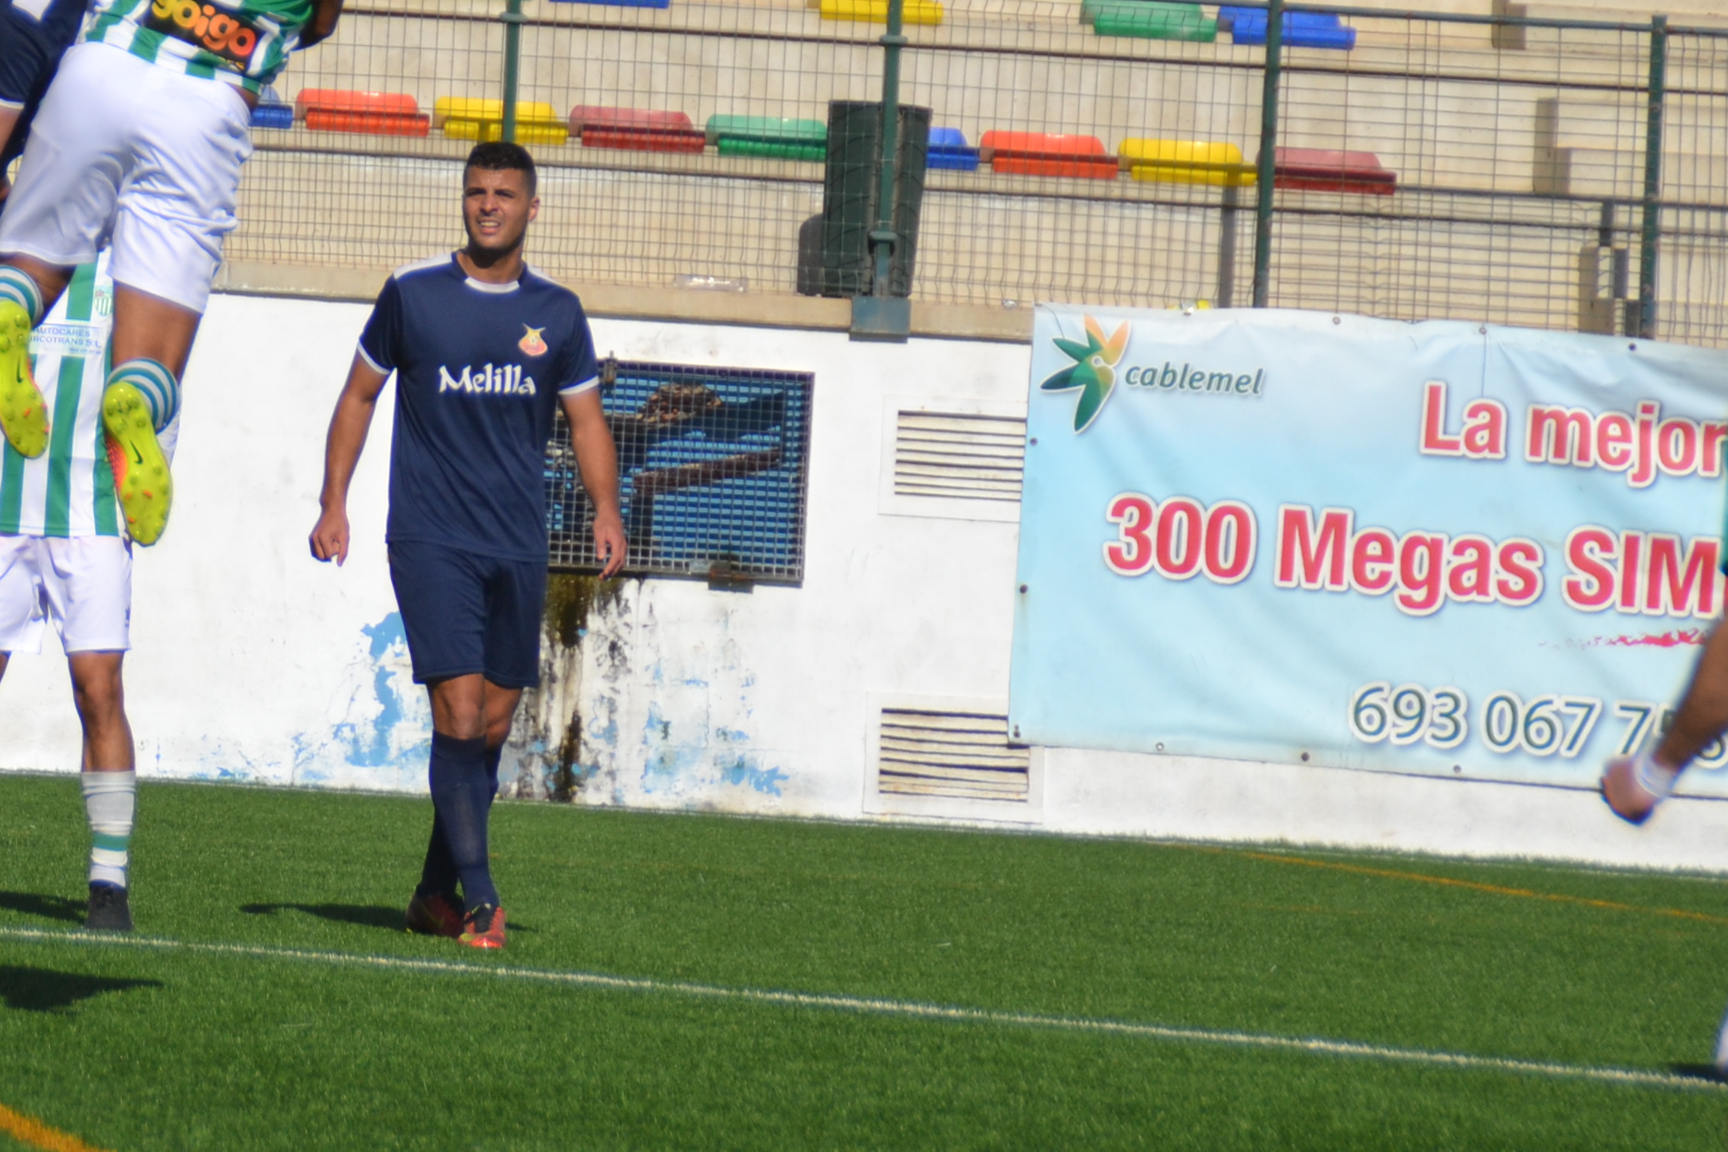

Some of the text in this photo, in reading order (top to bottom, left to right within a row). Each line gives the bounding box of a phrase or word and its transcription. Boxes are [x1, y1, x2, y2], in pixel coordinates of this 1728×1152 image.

[439, 363, 536, 395] Melilla
[1125, 361, 1264, 394] cablemel
[1422, 382, 1728, 484] La mejor
[1106, 494, 1720, 614] 300 Megas SIM
[1352, 684, 1463, 743] 693
[1484, 693, 1597, 753] 067
